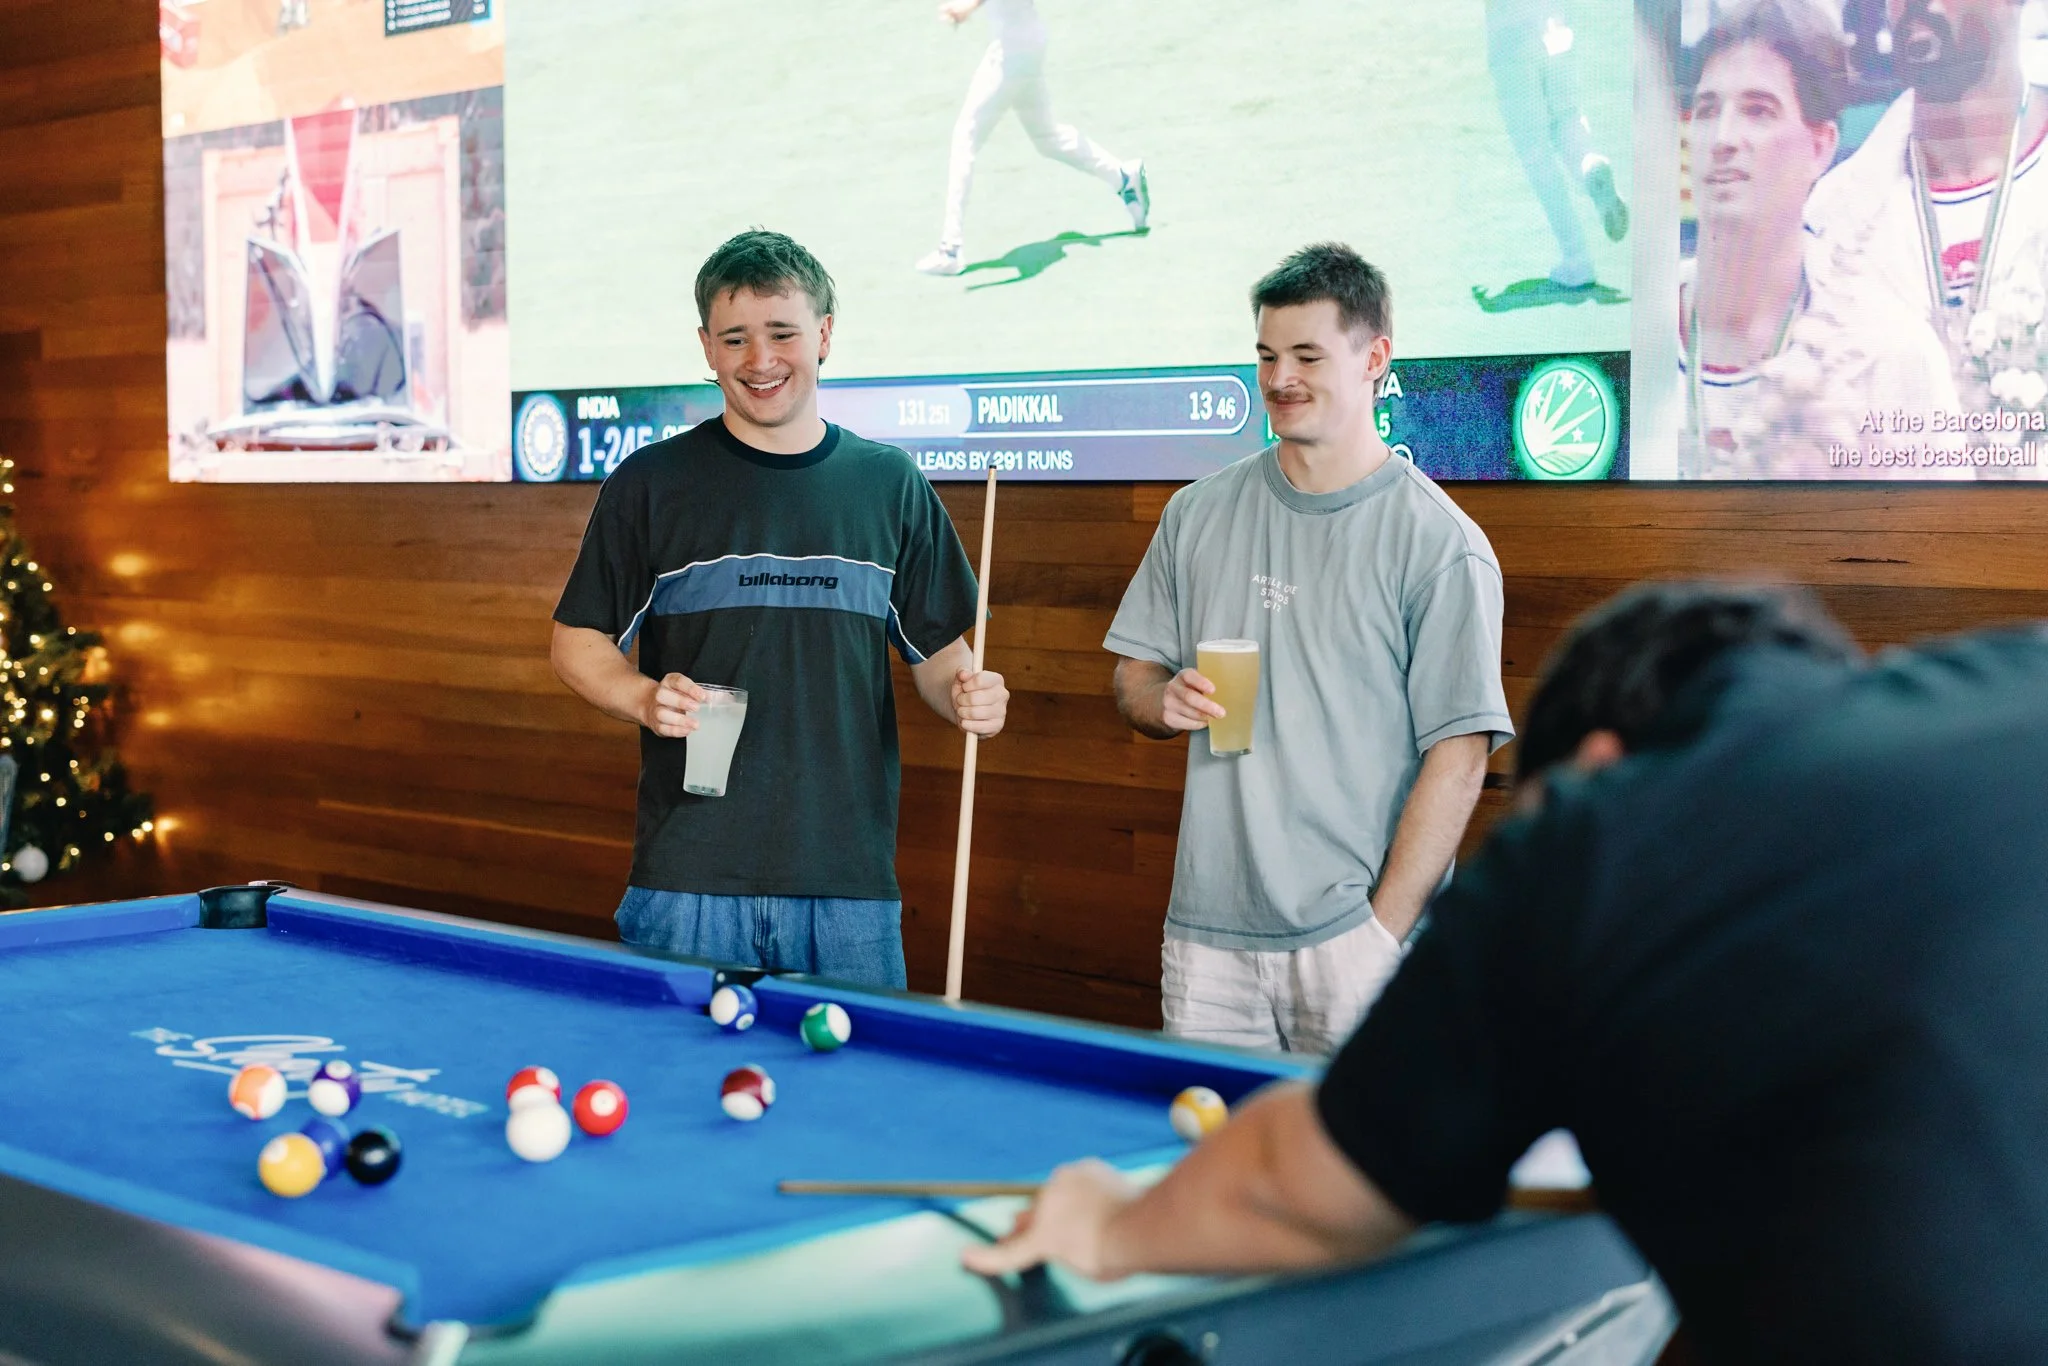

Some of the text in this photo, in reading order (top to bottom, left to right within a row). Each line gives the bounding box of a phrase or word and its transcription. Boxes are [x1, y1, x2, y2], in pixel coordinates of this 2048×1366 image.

[577, 395, 620, 419] INDIA
[897, 399, 927, 426] 131
[978, 390, 1236, 424] PADIKKAL 13 46
[1859, 408, 2046, 433] At the Barcelona
[916, 450, 1074, 471] LEADS BY 291 RUNS
[1828, 443, 1862, 467] the
[1869, 443, 1915, 467] best
[1922, 441, 2037, 467] basketball
[738, 572, 839, 590] billabong
